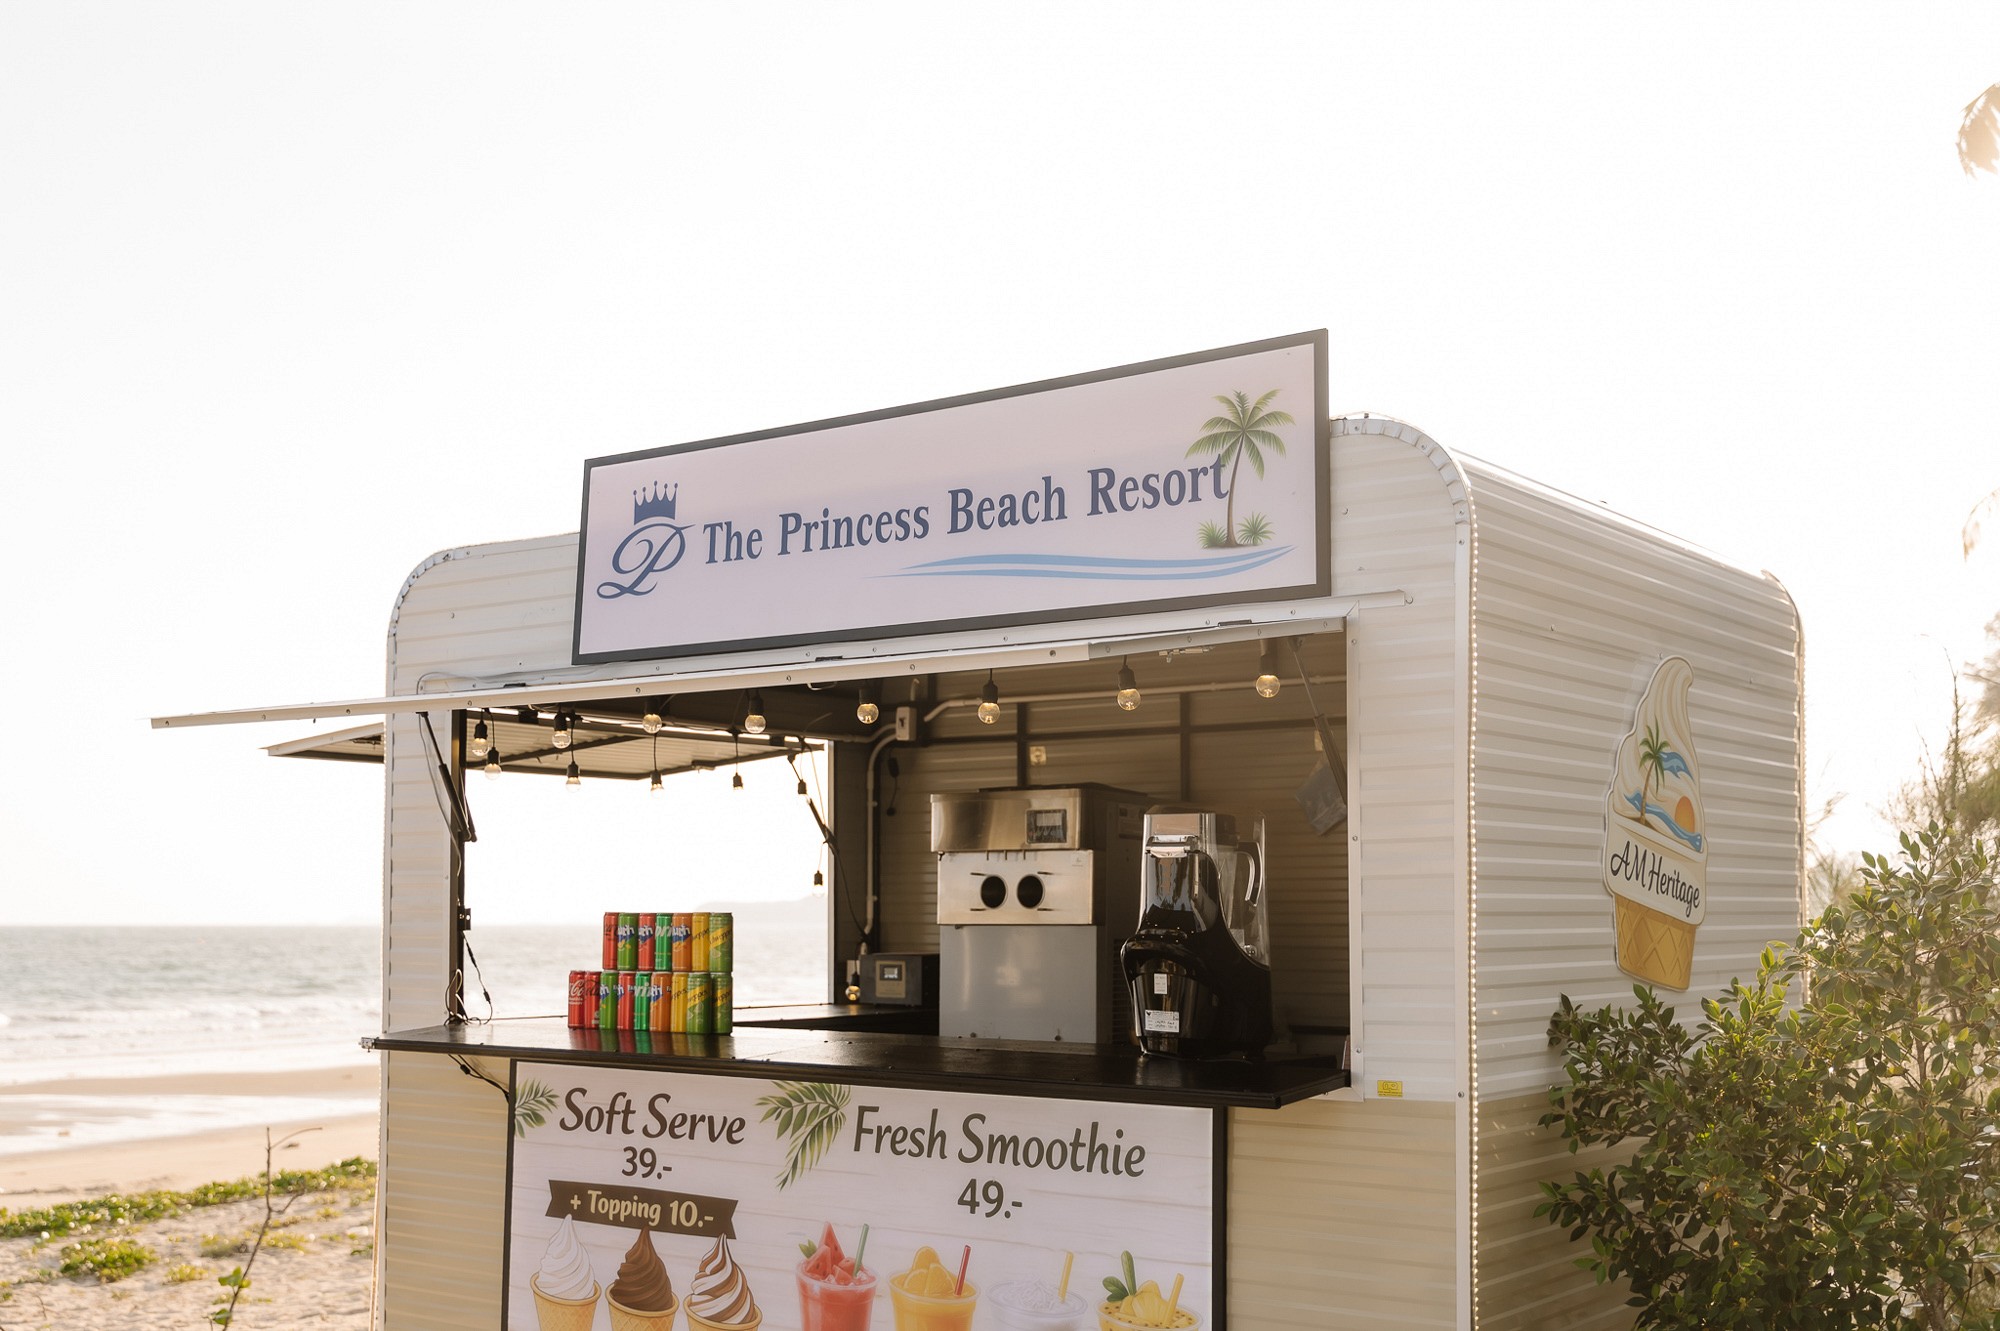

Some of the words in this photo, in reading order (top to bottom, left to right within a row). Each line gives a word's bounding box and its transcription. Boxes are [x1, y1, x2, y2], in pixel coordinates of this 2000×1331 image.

[702, 521, 763, 564] The
[778, 507, 929, 556] Princess
[947, 475, 1067, 534] Beach
[1087, 453, 1229, 516] Resort
[1610, 840, 1648, 888] AM
[1648, 852, 1700, 918] Heritage
[559, 1087, 637, 1135] Soft
[642, 1093, 746, 1144] Serve
[853, 1105, 948, 1159] Fresh
[957, 1113, 1146, 1177] Smoothie
[621, 1146, 673, 1180] 39.-
[587, 1189, 662, 1227] Topping
[669, 1200, 714, 1228] 10.-
[957, 1178, 1023, 1219] 49.-
